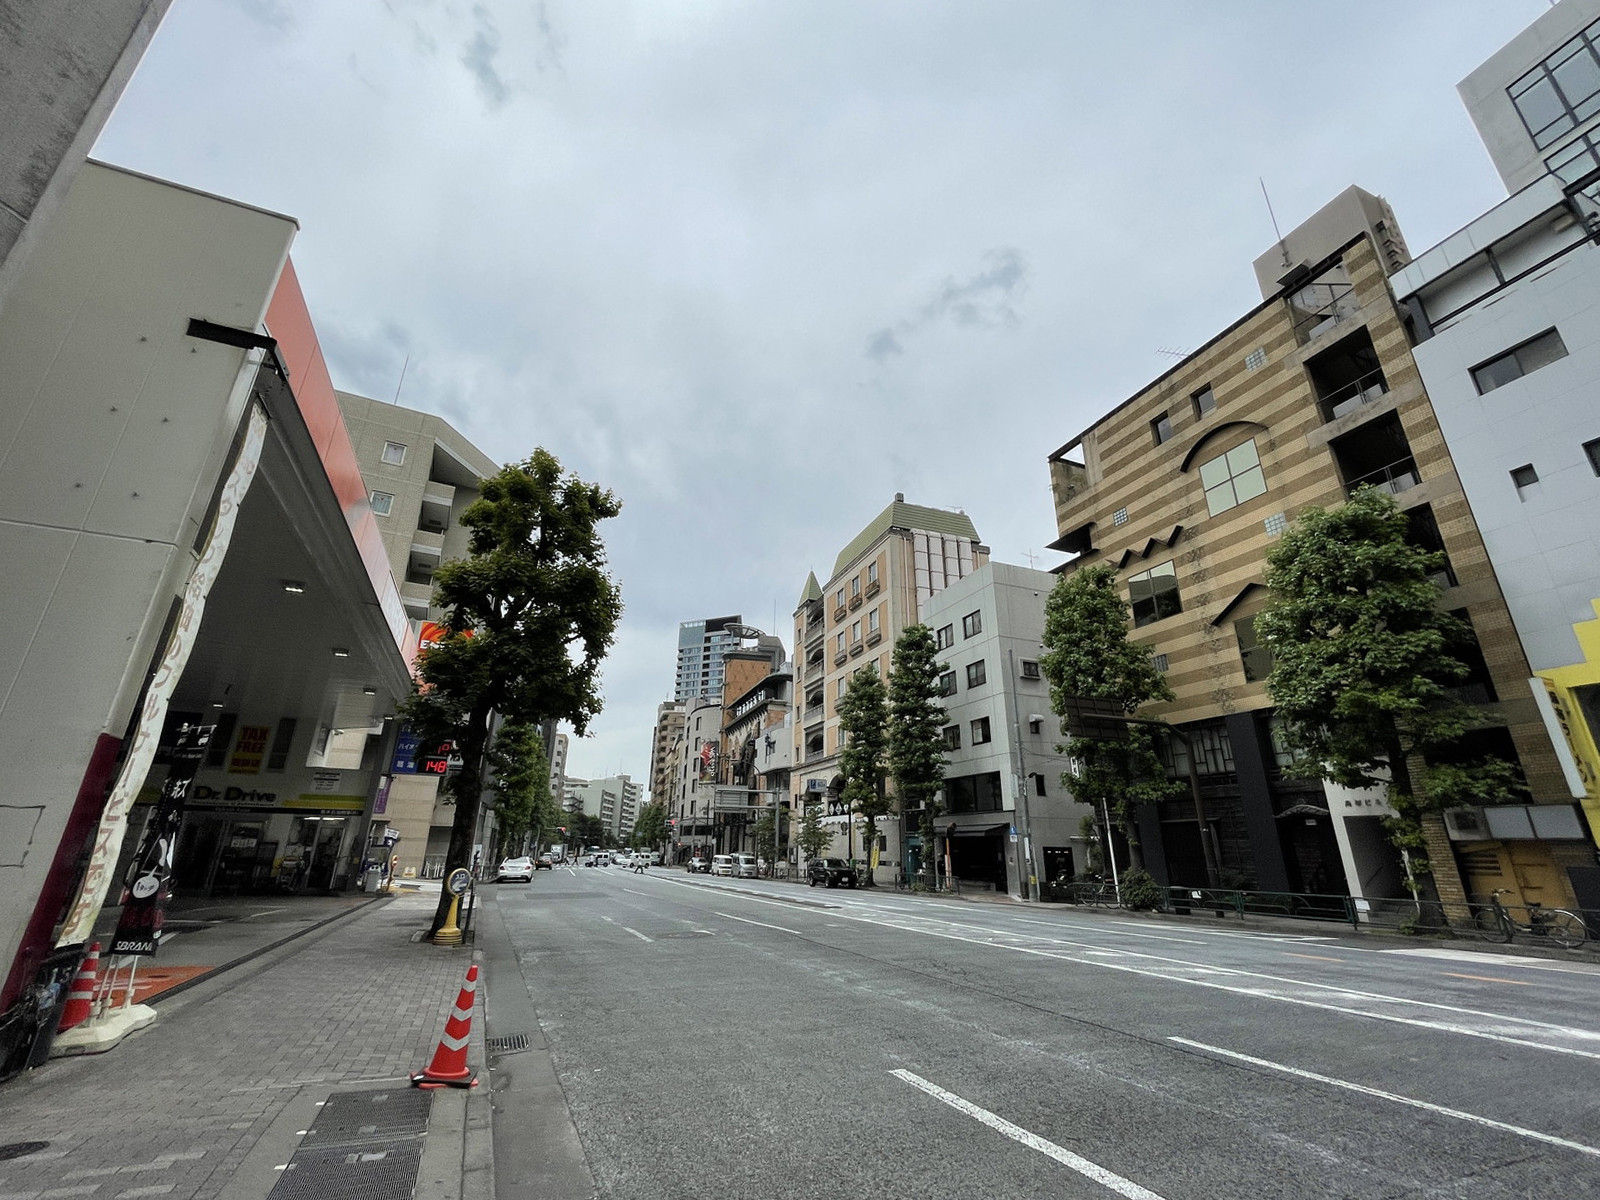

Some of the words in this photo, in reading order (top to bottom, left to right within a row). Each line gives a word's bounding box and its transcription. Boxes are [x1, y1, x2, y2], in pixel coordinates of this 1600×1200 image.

[236, 741, 265, 753] FREE
[398, 743, 418, 751] ハイオ
[425, 760, 447, 773] 148
[224, 786, 276, 801] Drive
